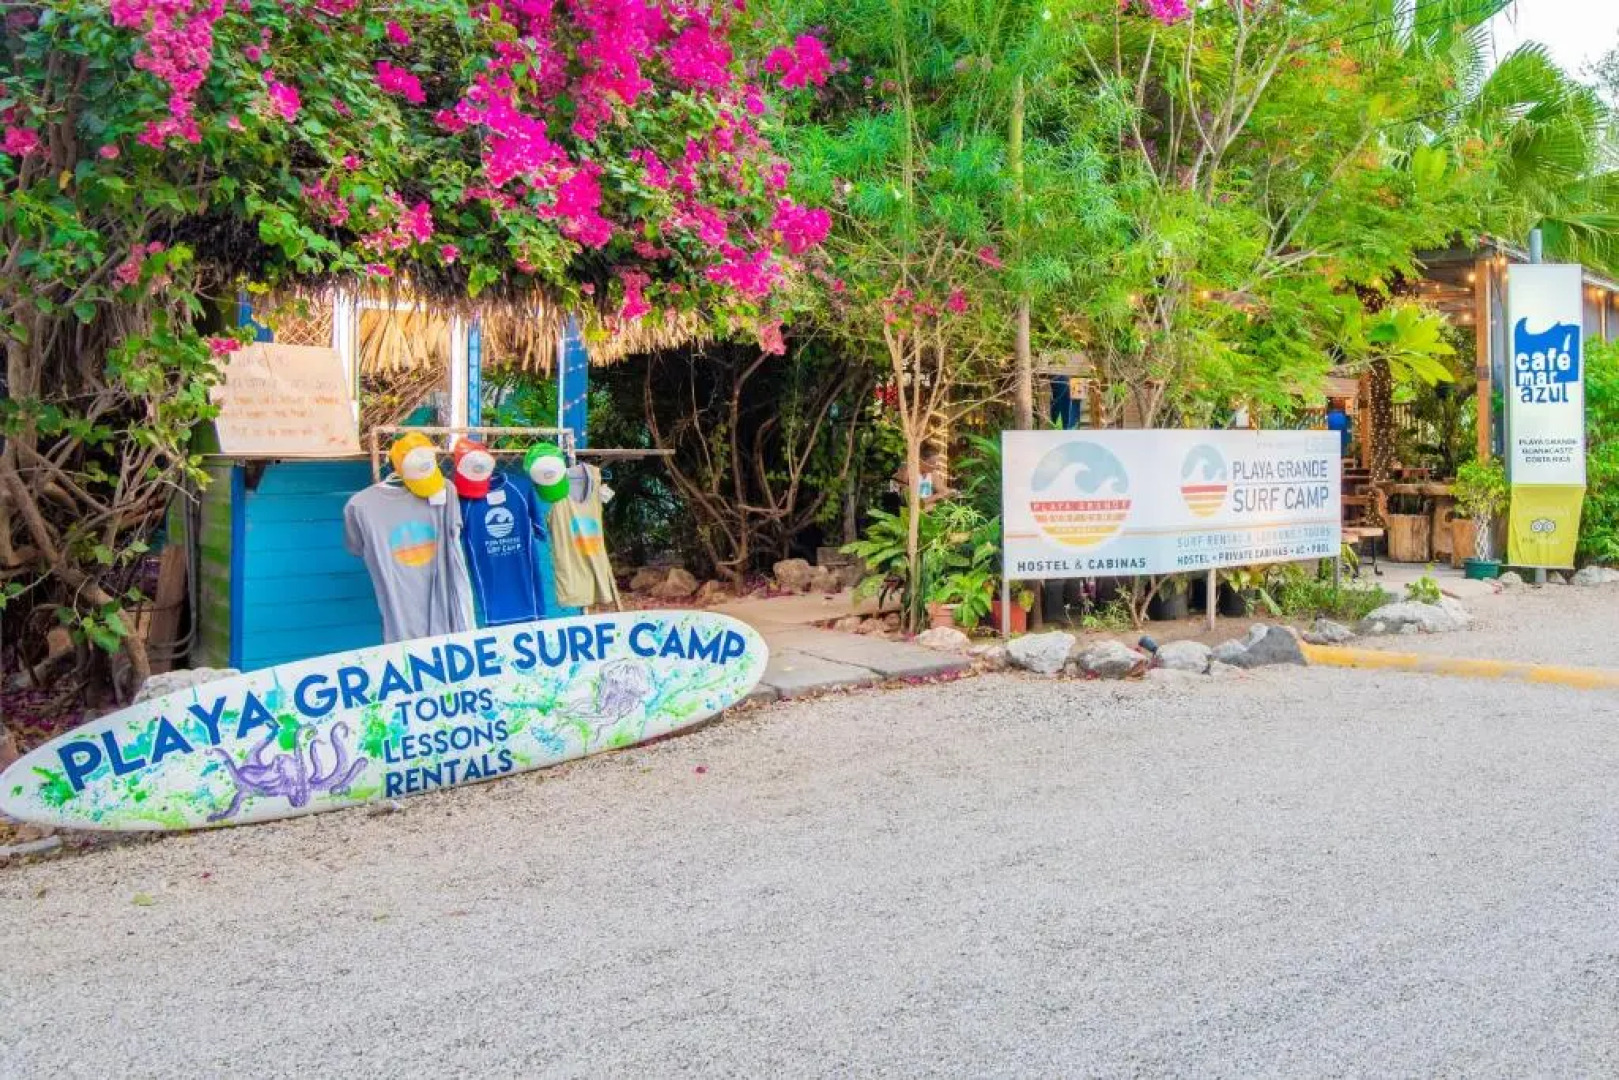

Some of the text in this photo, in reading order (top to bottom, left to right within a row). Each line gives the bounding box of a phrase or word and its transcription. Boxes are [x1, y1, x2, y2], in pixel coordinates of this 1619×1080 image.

[1516, 333, 1571, 371] café
[1518, 371, 1558, 386] mar
[1520, 386, 1569, 403] azul
[1232, 459, 1329, 480] PLAYA GRANDE
[1232, 486, 1329, 513] SURF CAMP
[1017, 557, 1147, 572] HOSTEL & CABINAS
[1177, 553, 1211, 566] HOSTEL
[1218, 549, 1252, 563] PRIVATE
[1254, 546, 1288, 560] CABINAS
[57, 622, 746, 792] PLAYA GRANDE SURF CAMP
[394, 687, 494, 726] TOURS
[383, 719, 509, 764] LESSONS
[385, 748, 514, 798] RENTALS
